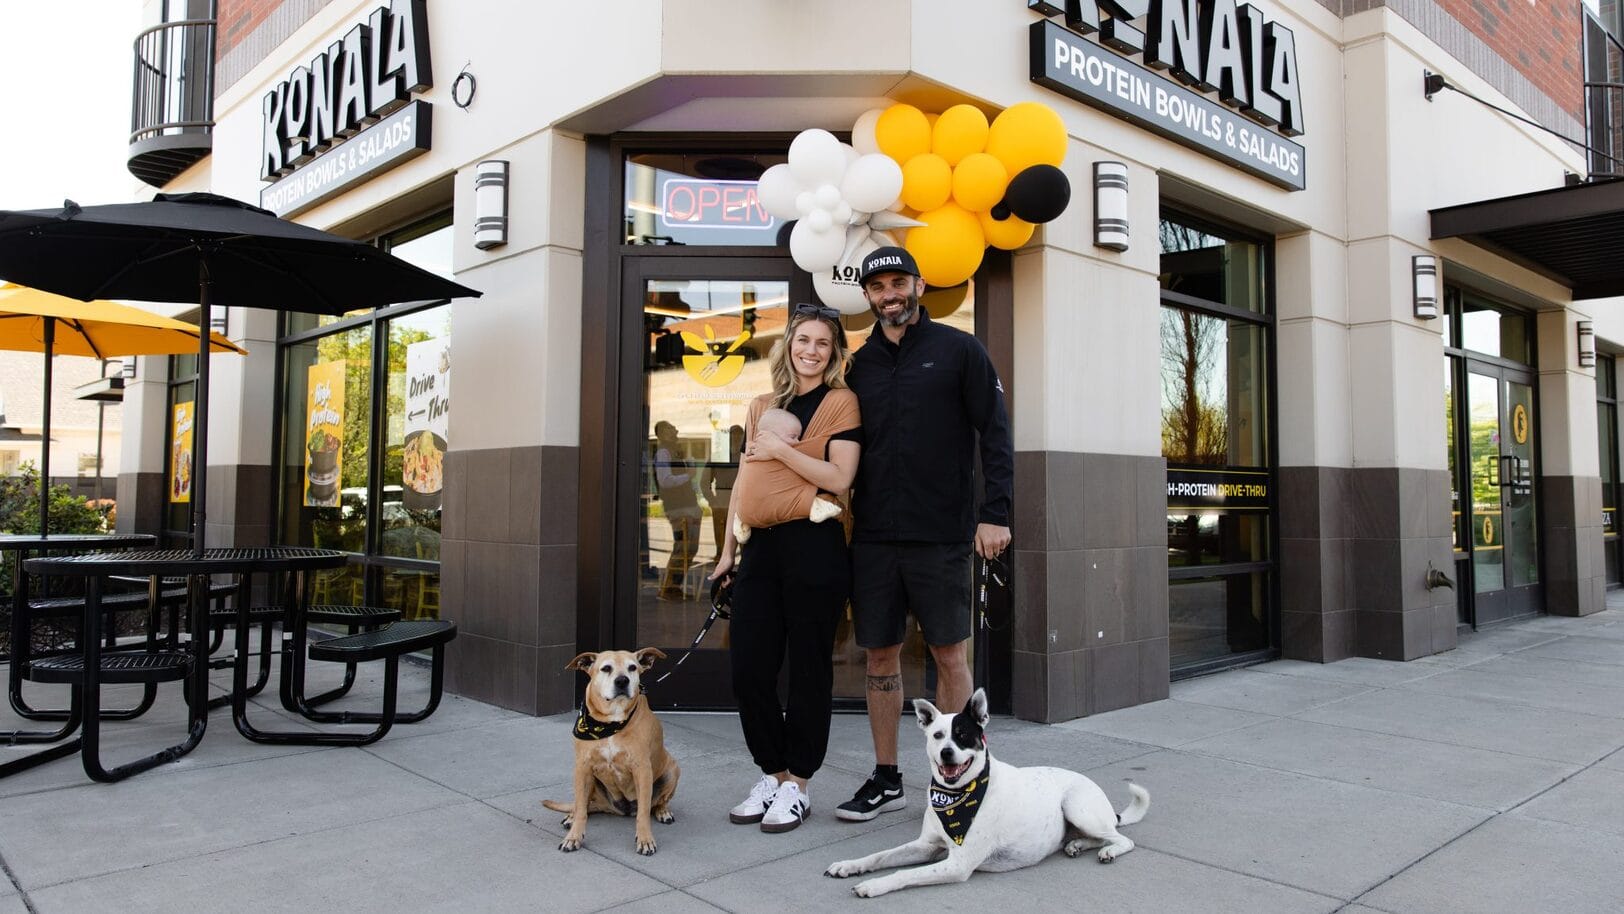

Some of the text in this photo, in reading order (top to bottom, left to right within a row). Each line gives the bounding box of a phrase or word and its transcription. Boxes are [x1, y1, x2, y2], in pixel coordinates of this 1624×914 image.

[1040, 0, 1304, 136] NALA
[261, 0, 421, 180] KONALA
[1055, 38, 1299, 176] PROTEIN BOWLS & SALADS
[263, 115, 412, 212] PROTEIN BOWLS & SALADS
[668, 185, 769, 222] OPEN
[832, 265, 862, 282] KON
[868, 255, 903, 271] KONALA
[409, 372, 435, 399] Drive
[1168, 483, 1267, 497] H-PROTEIN DRIVE-THRU
